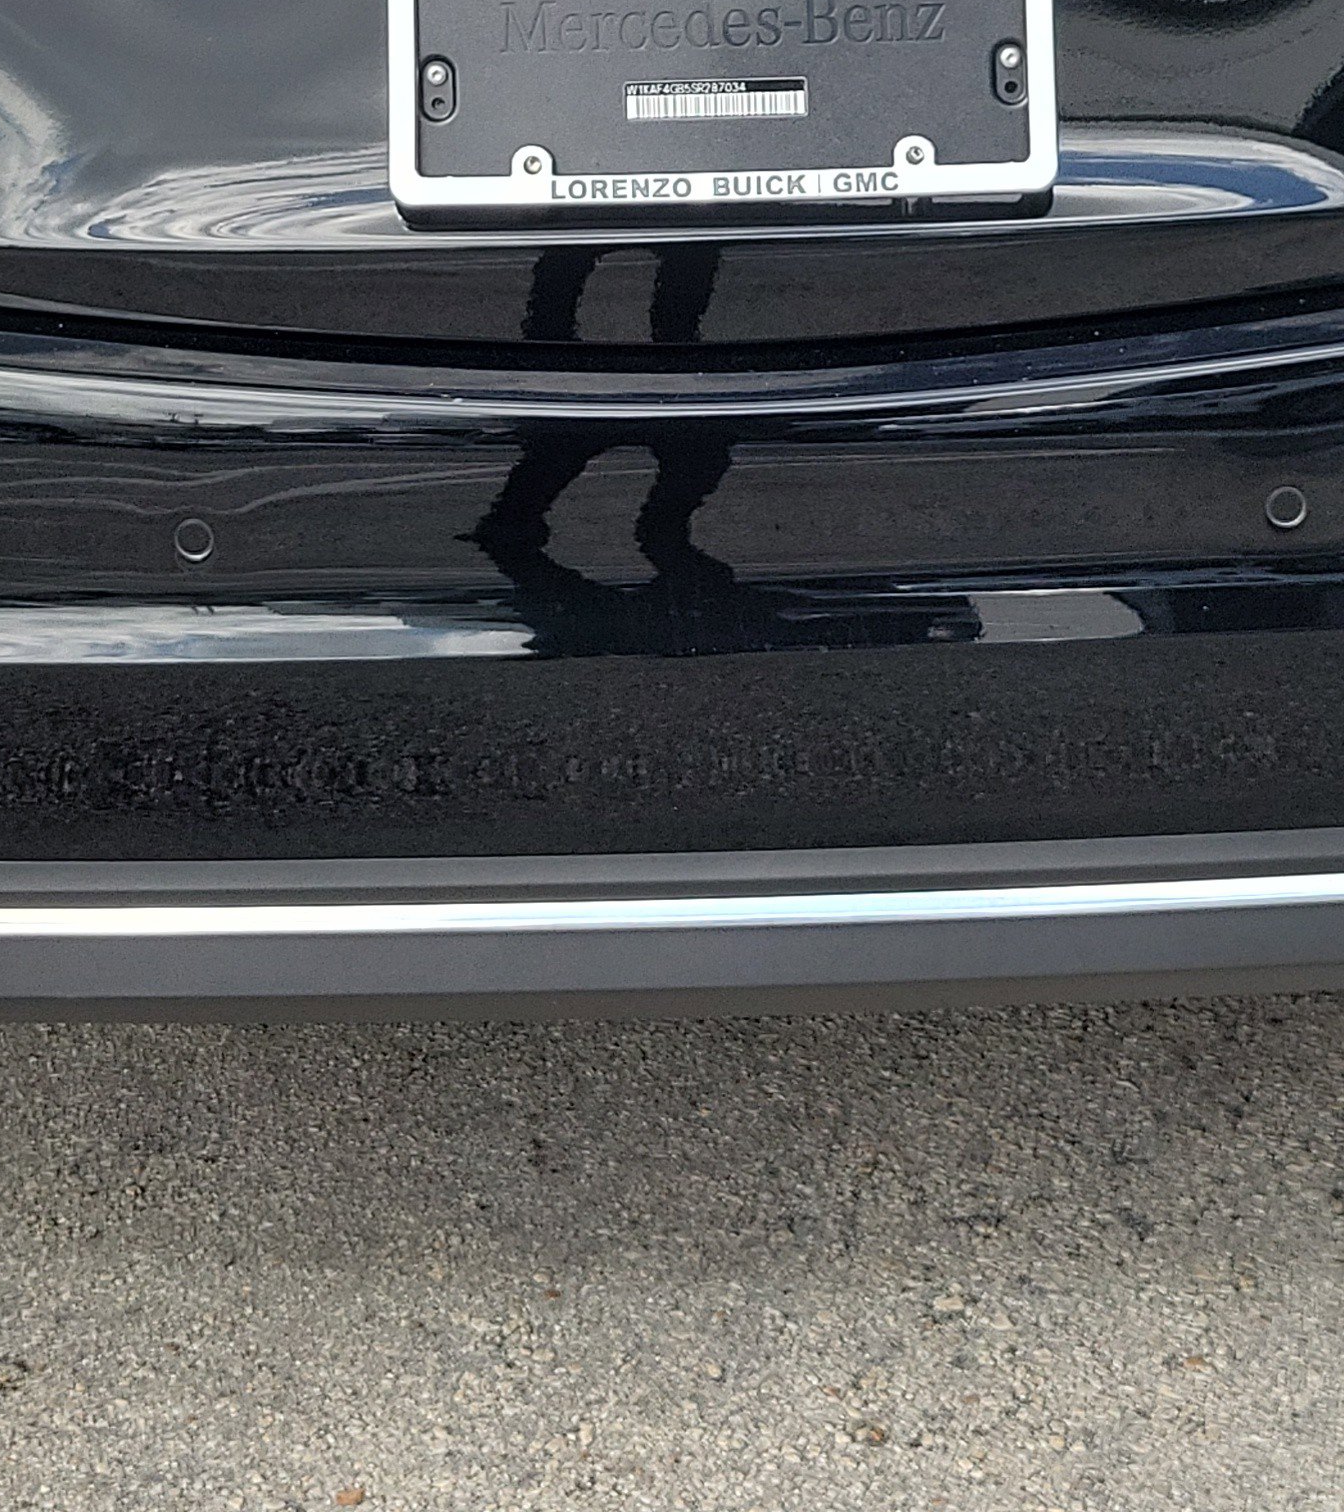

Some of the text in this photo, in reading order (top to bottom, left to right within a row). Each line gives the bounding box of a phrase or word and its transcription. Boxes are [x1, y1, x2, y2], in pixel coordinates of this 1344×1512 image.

[626, 82, 747, 95] W1KAF4GB5SR287034
[551, 170, 900, 201] LORENZO BUICK GMC
